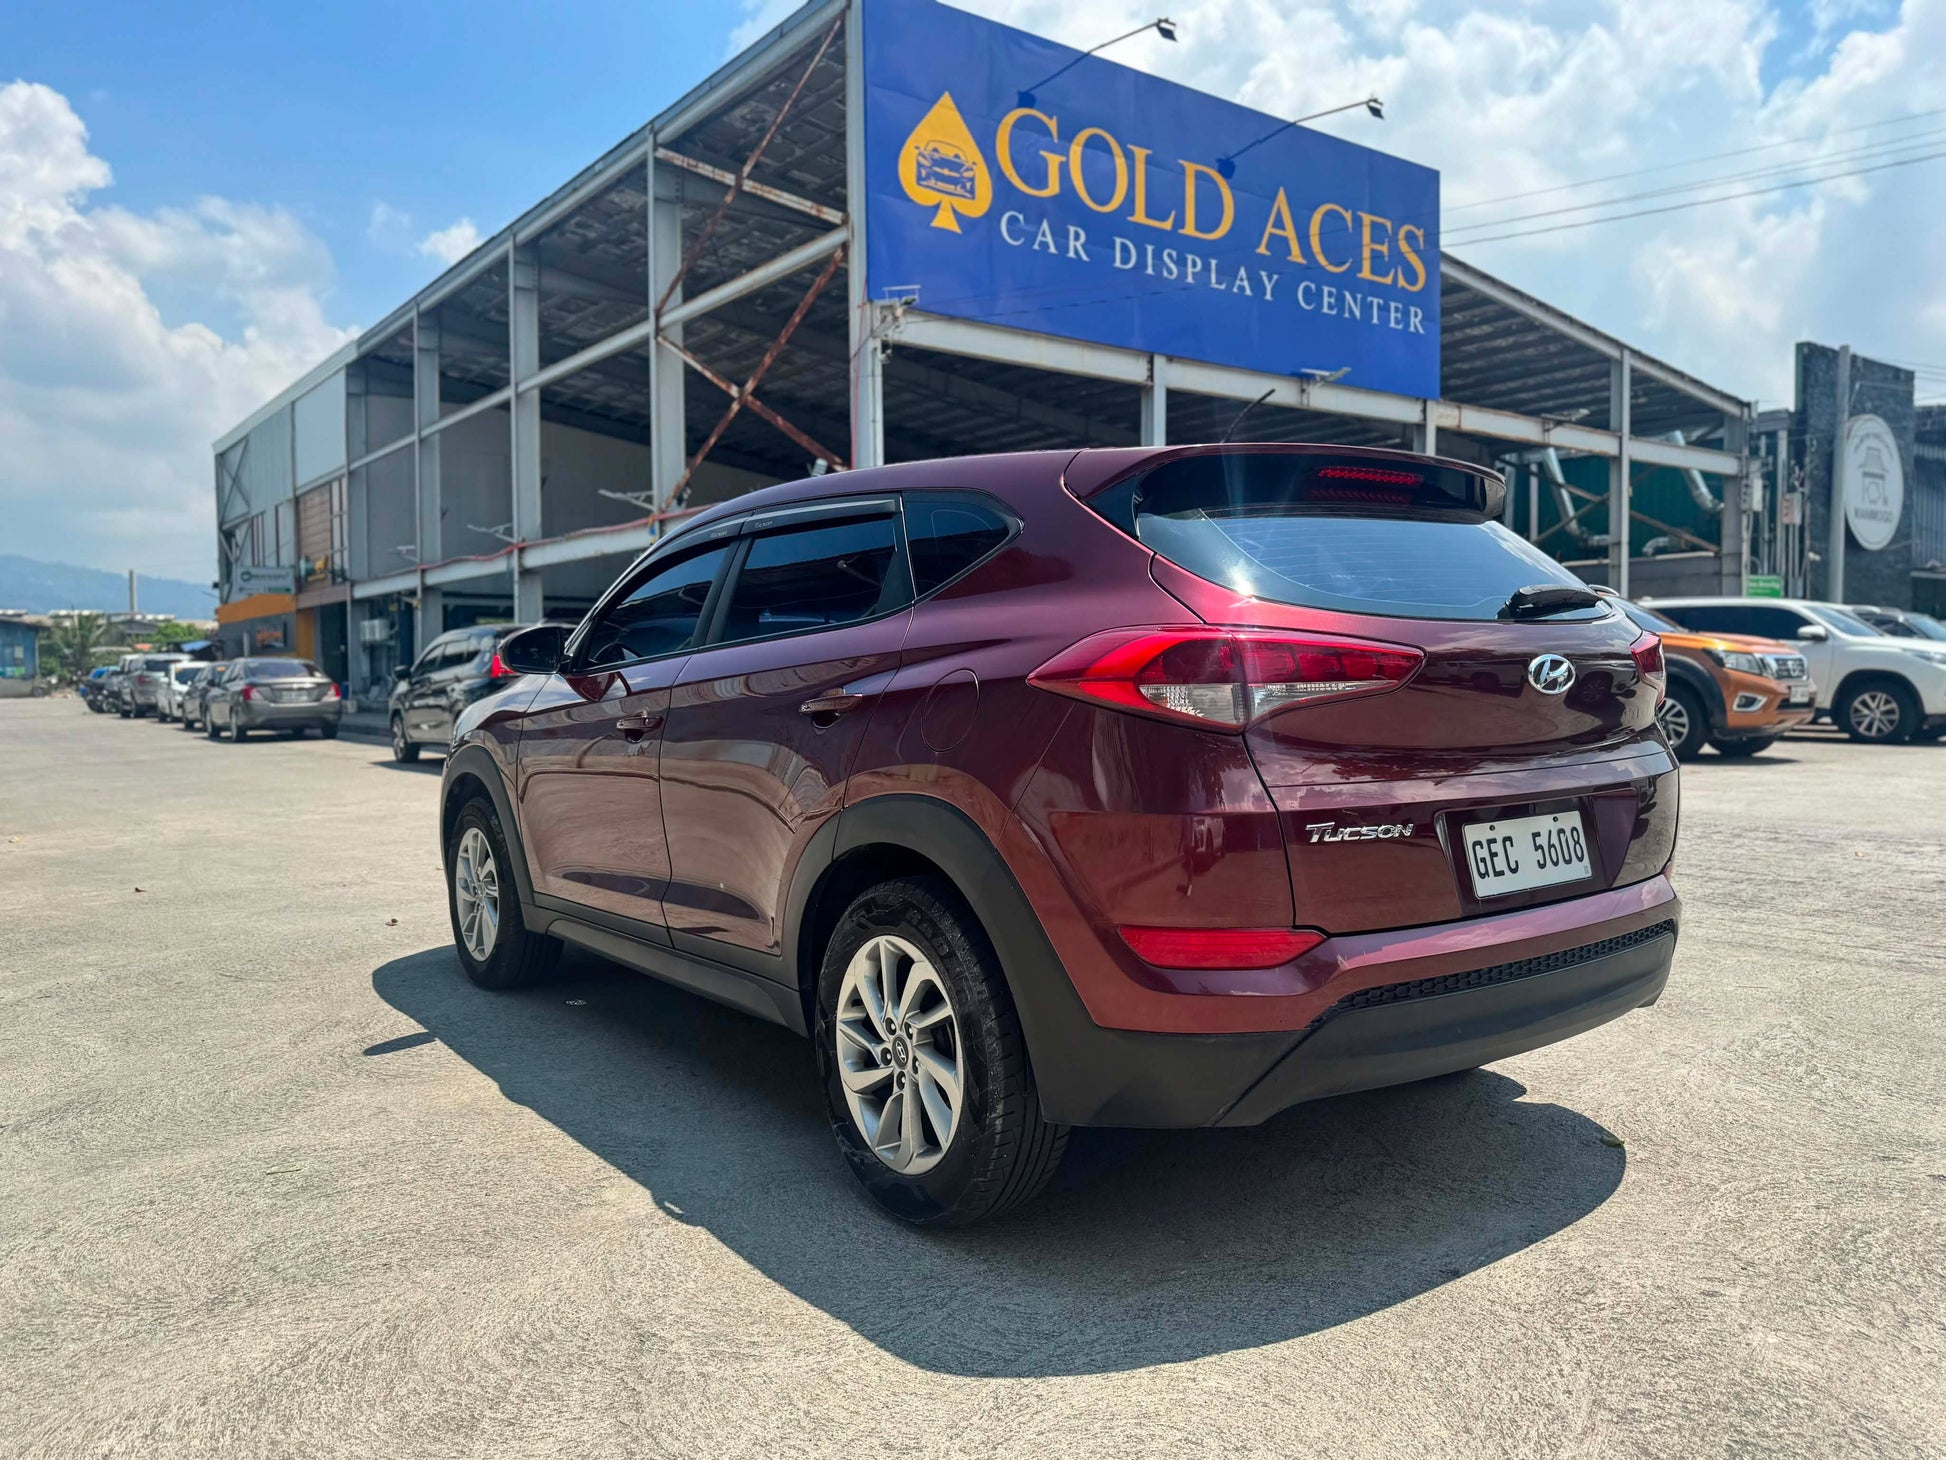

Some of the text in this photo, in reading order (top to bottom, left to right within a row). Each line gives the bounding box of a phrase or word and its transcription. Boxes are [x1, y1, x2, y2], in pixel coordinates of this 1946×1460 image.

[996, 107, 1427, 293] GOLD ACES
[1000, 210, 1426, 334] CAR DISPLAY CENTER
[1472, 826, 1585, 880] GEC 5608
